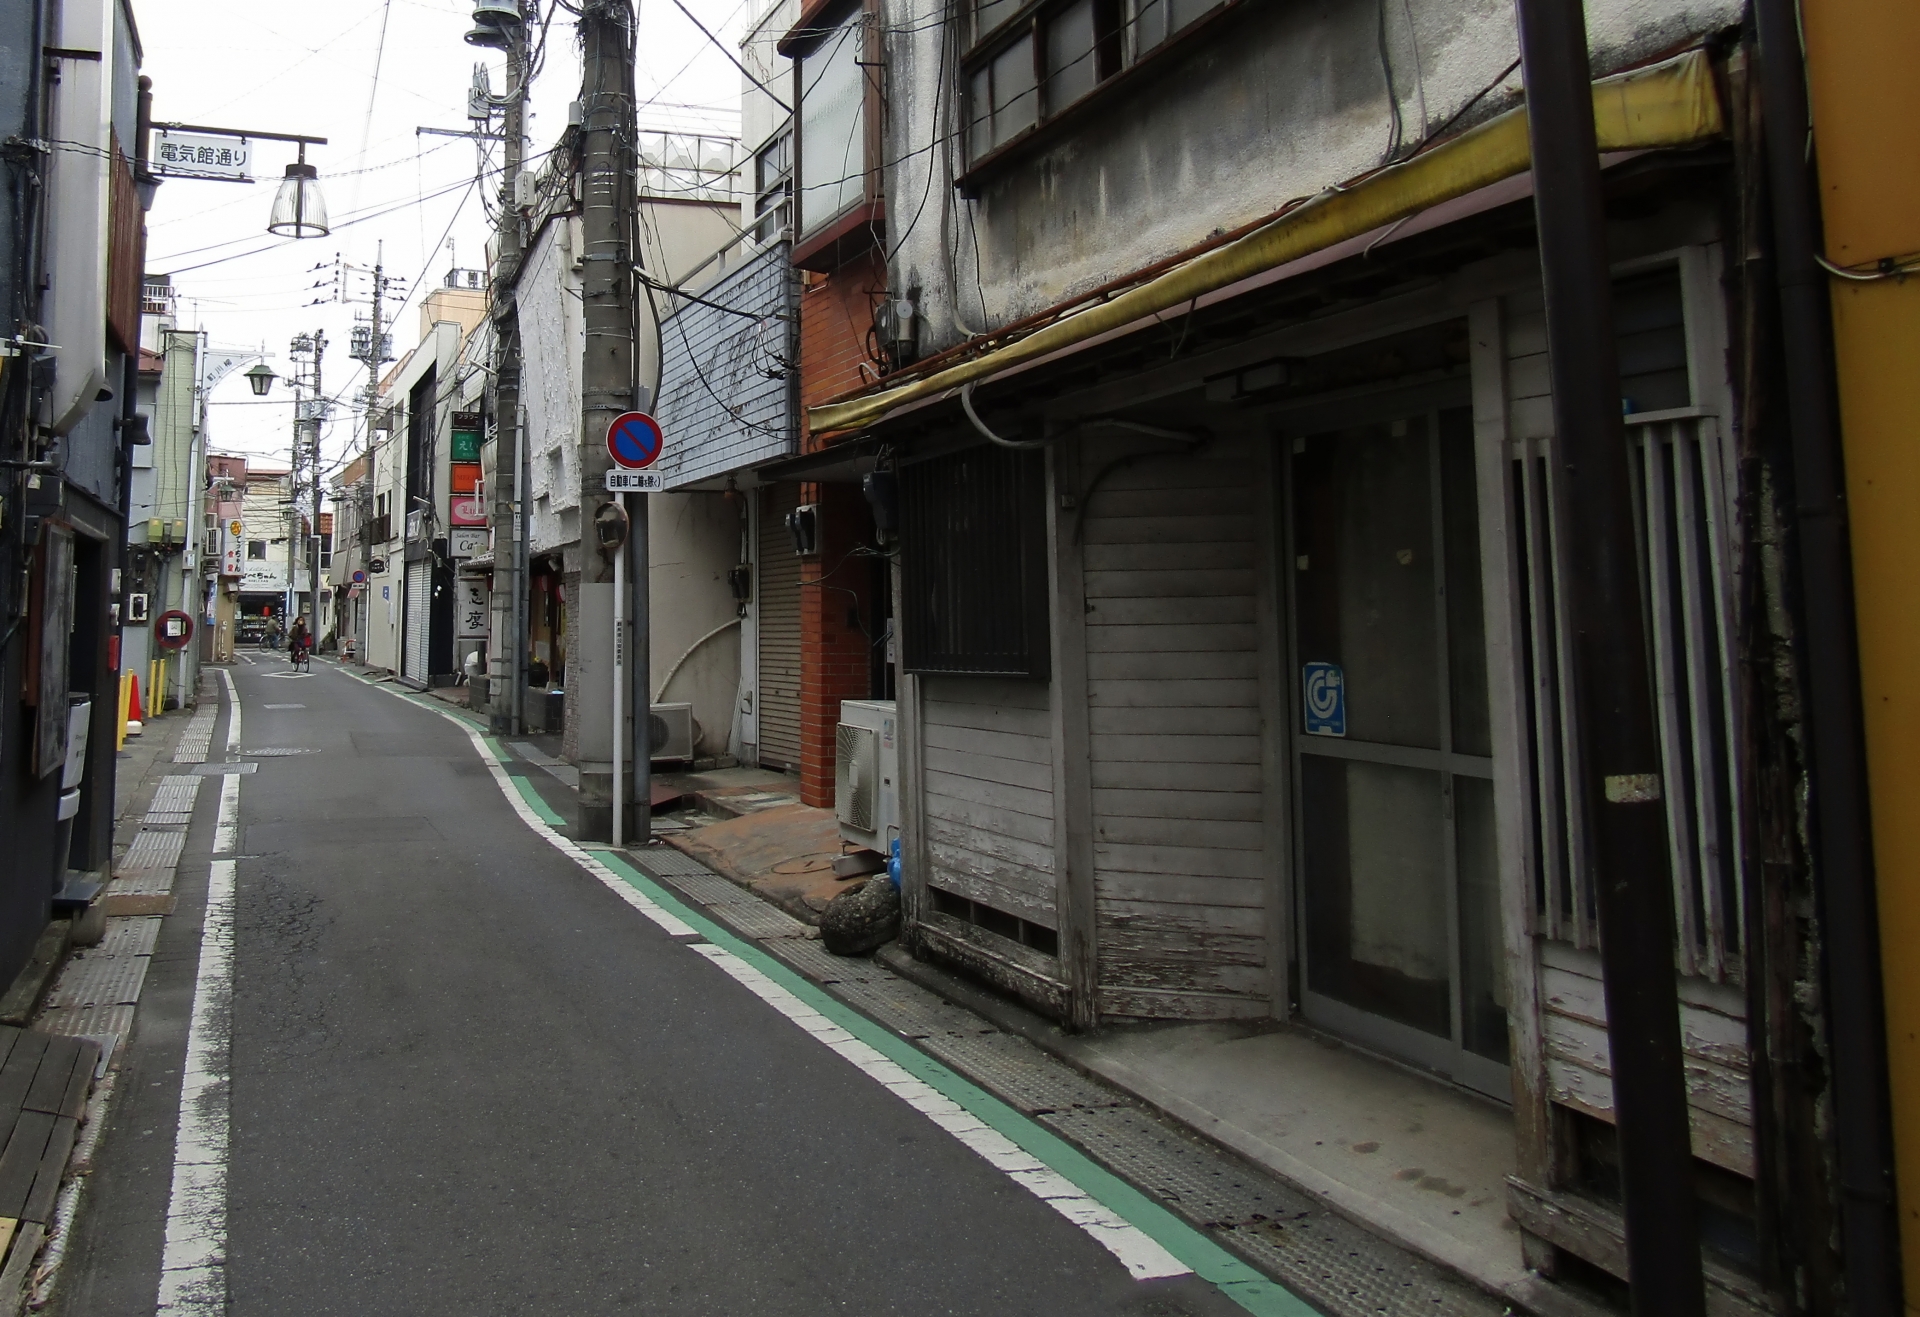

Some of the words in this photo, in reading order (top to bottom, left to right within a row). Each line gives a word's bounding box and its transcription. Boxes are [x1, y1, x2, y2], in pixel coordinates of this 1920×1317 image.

[160, 143, 247, 167] 電気館通り
[234, 535, 242, 573] てっちゃん
